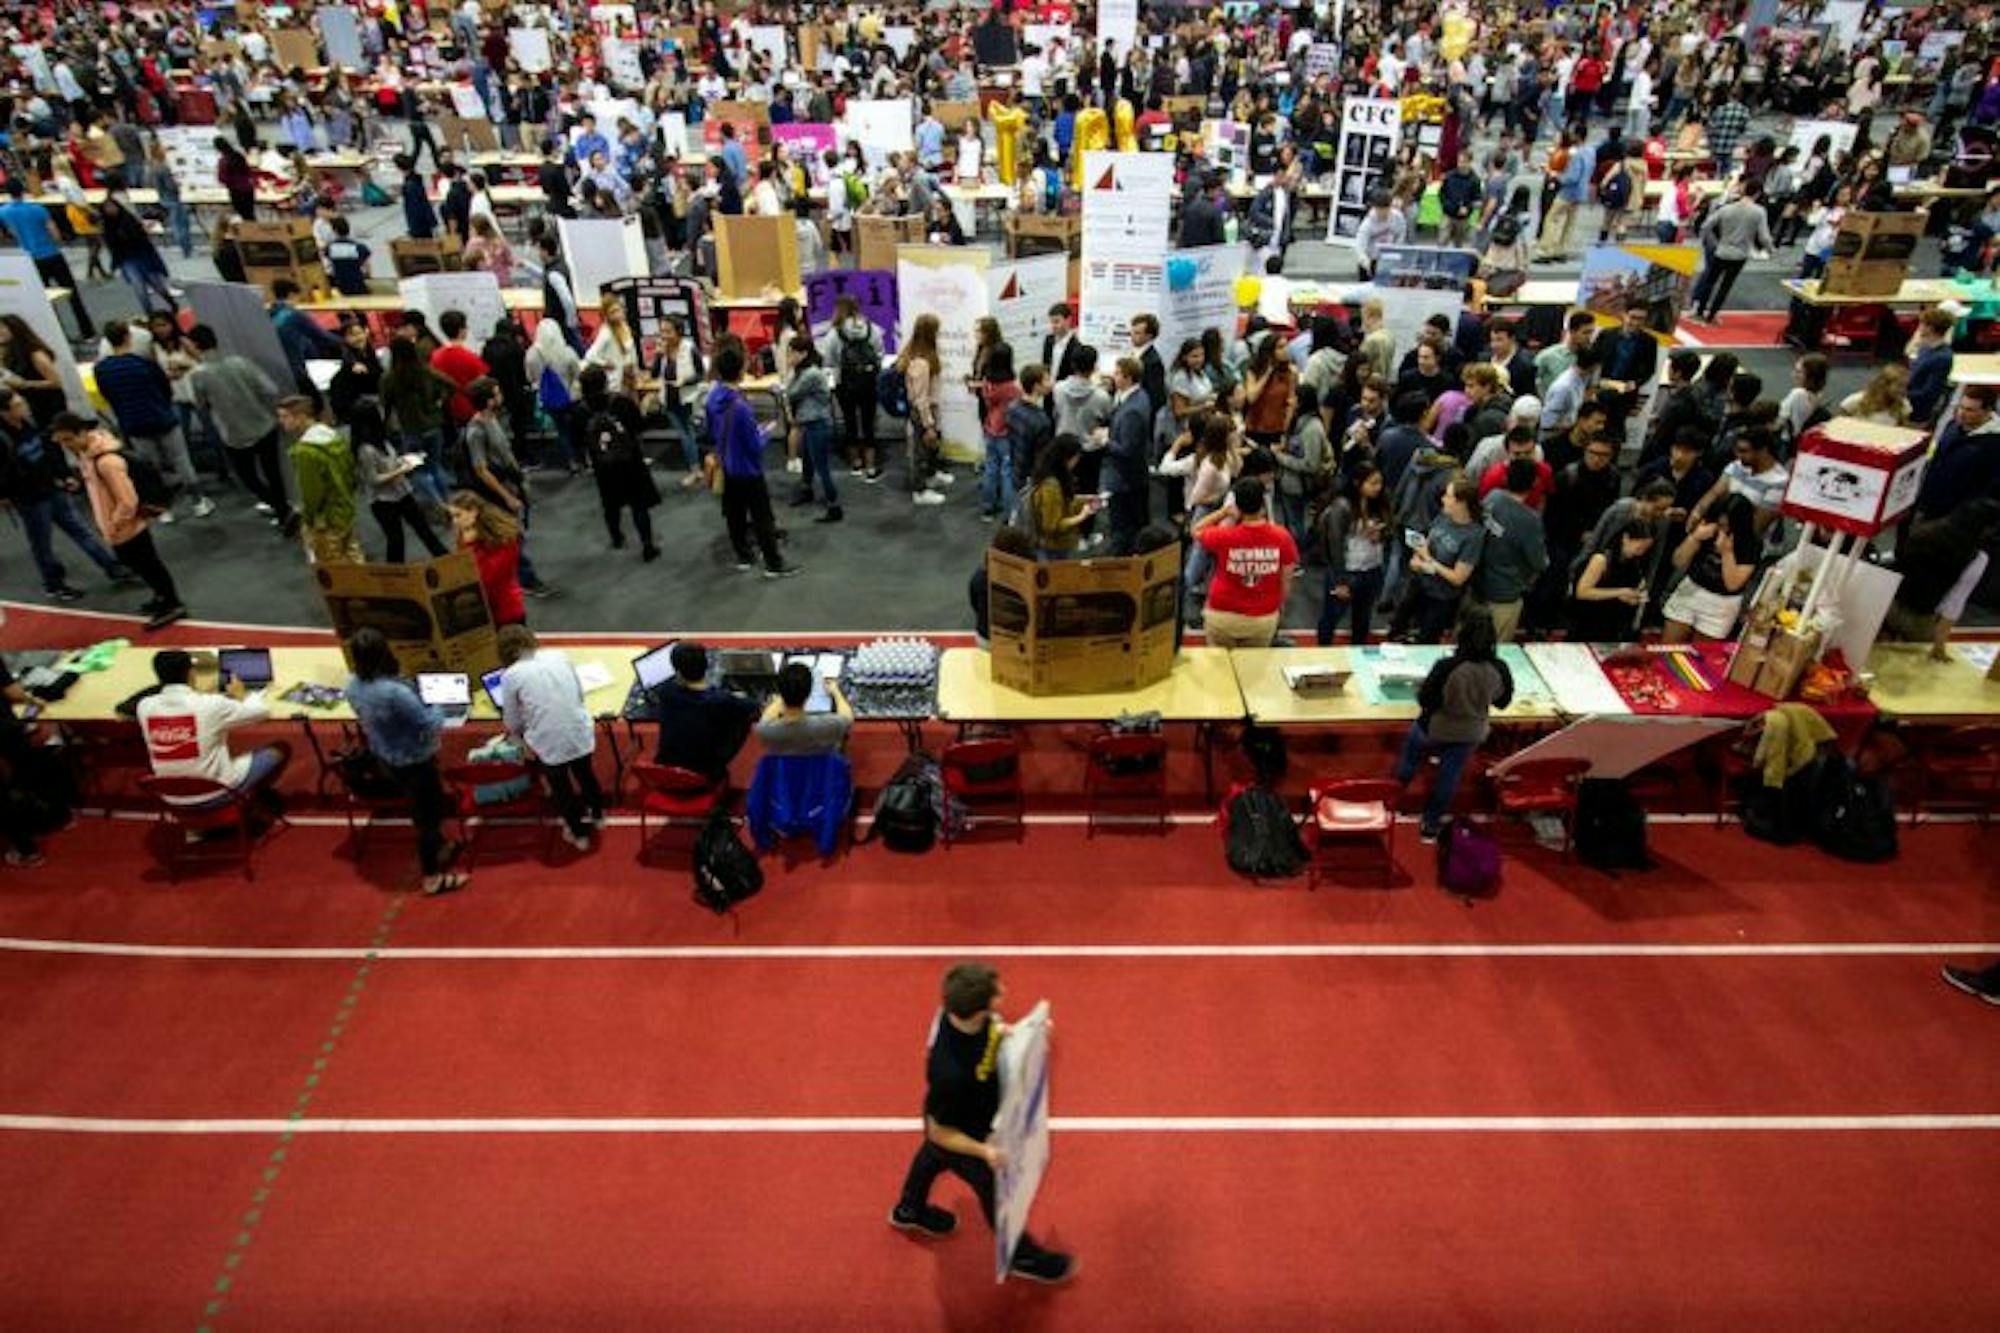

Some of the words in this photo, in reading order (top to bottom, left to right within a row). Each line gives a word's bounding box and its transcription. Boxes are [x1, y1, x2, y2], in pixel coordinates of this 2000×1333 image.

[1350, 103, 1395, 125] CFC
[1227, 547, 1281, 561] NEWMAN
[1226, 561, 1280, 577] NATION
